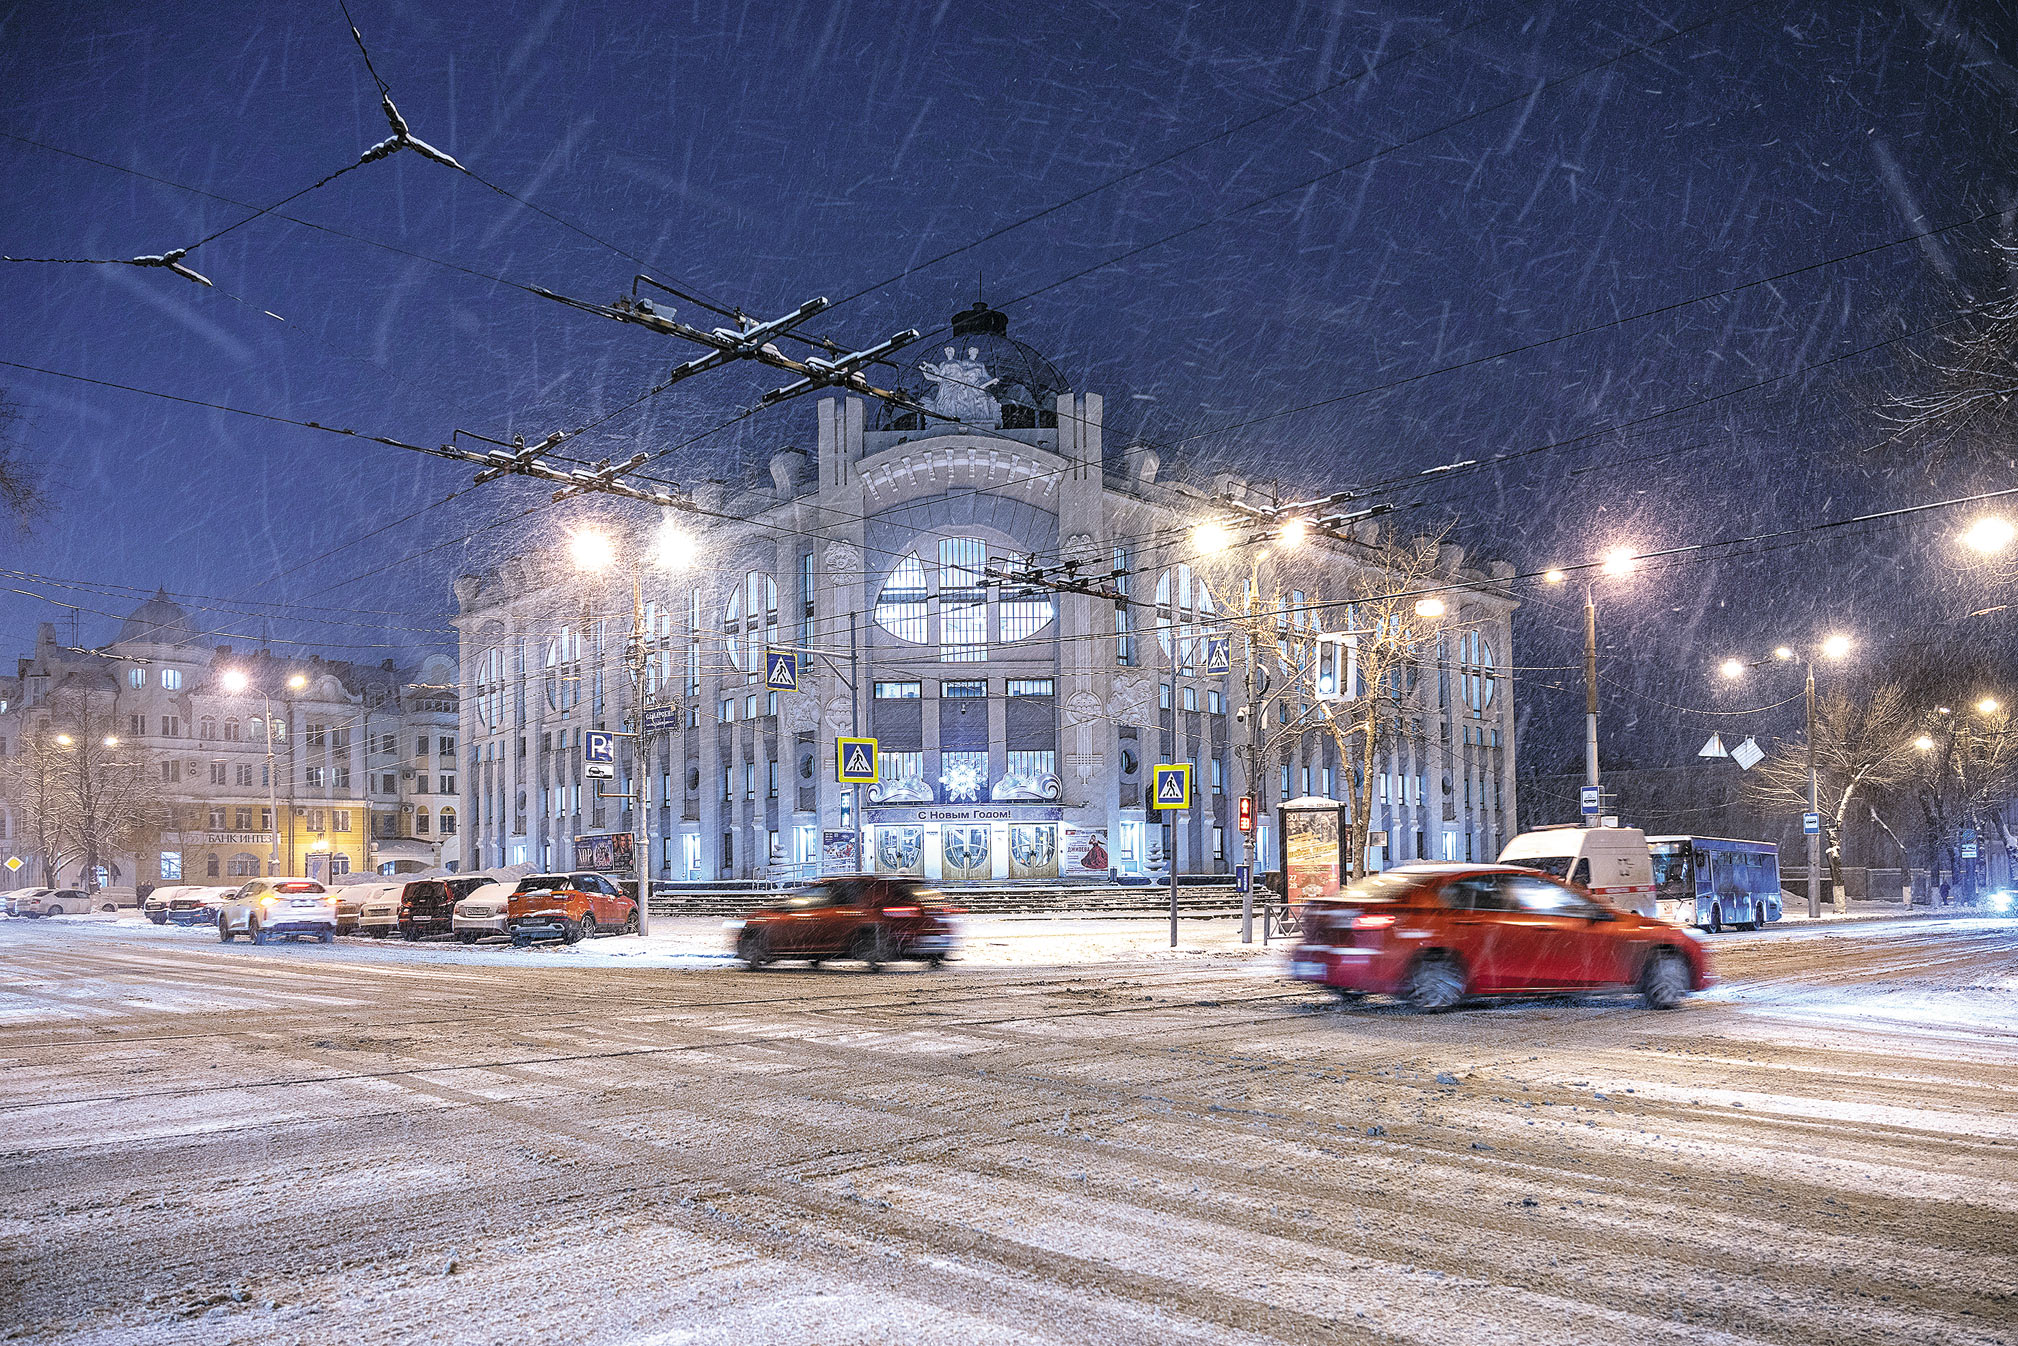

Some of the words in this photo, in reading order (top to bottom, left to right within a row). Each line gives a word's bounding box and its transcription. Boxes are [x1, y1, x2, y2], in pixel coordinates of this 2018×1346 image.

[918, 811, 927, 820] С
[930, 811, 970, 819] Новым
[973, 810, 1011, 819] Годом!
[208, 834, 237, 843] БАНК
[240, 834, 273, 843] ИНТЕЗ
